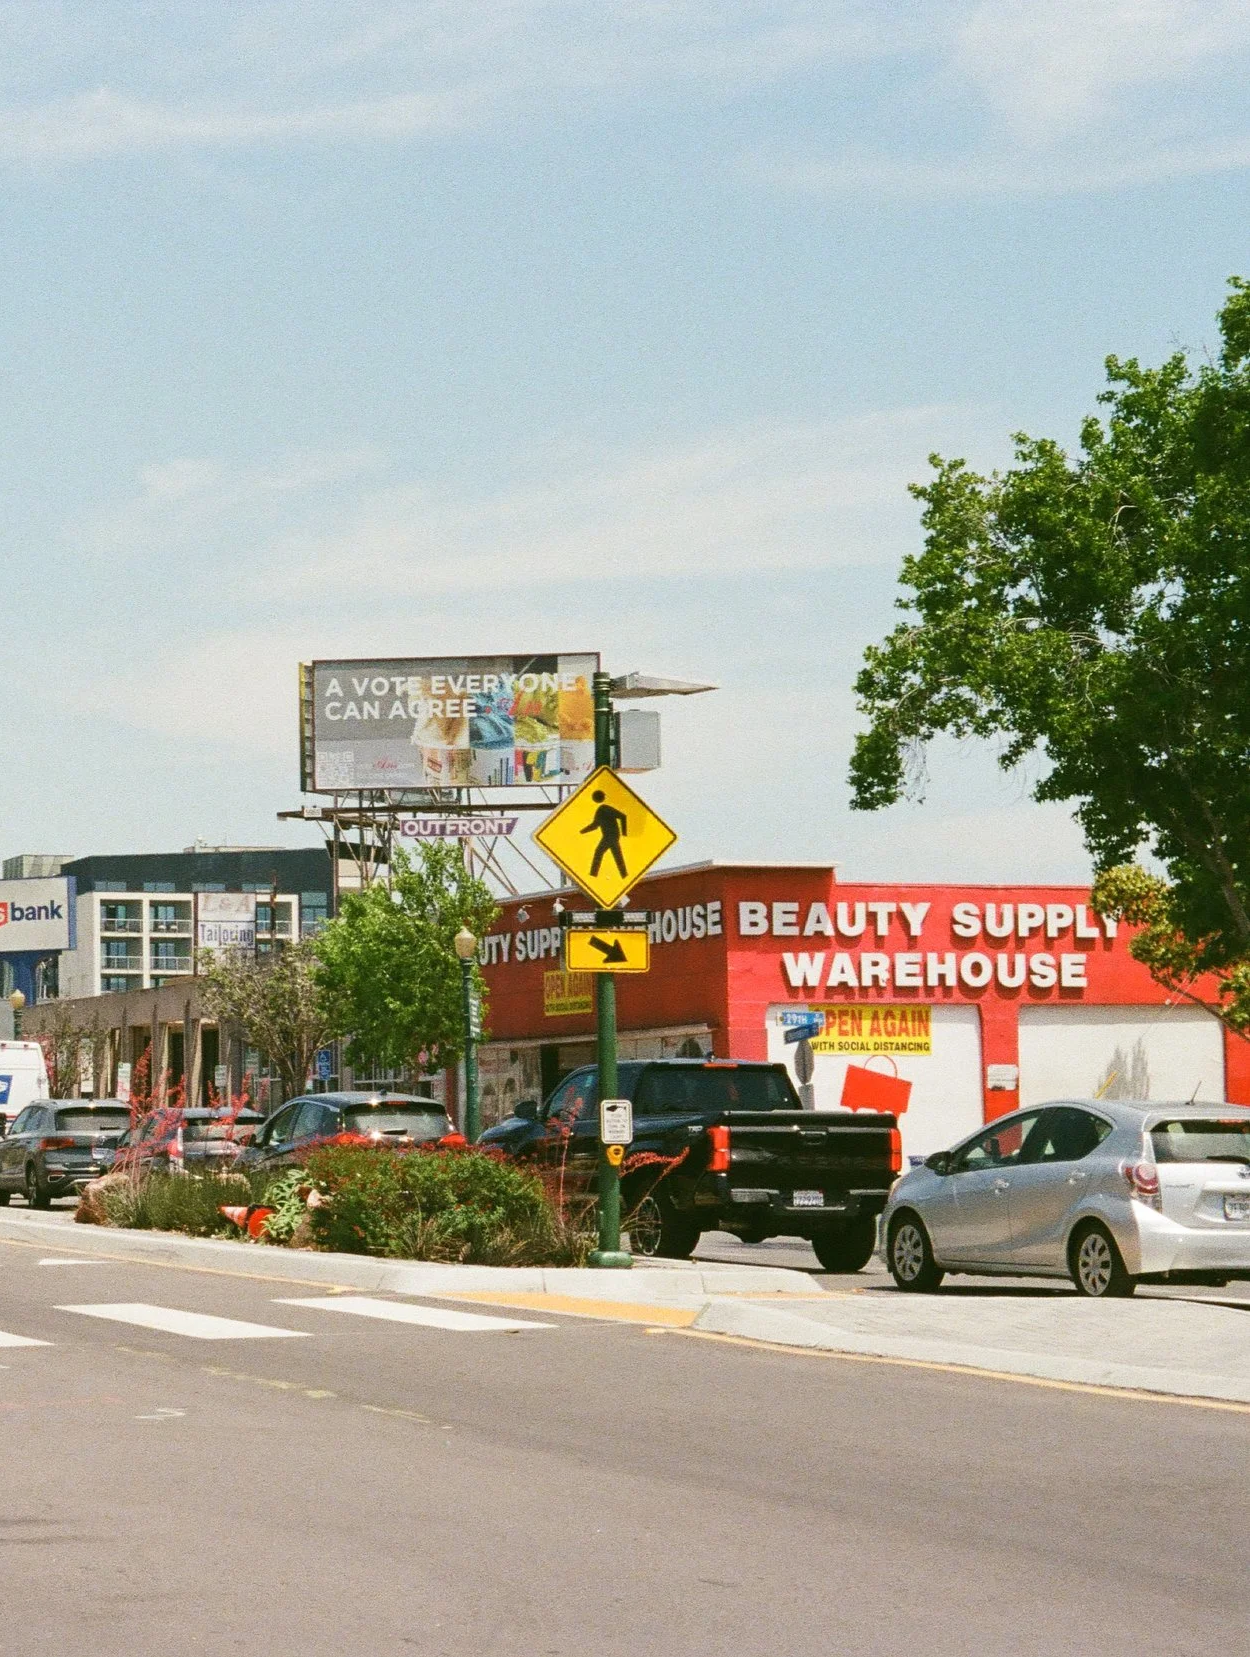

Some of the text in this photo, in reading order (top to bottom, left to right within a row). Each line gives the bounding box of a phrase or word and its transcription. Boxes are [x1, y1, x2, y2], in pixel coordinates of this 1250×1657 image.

[325, 672, 578, 698] A VOTE EVERYONE
[324, 700, 381, 721] CAN
[388, 698, 478, 719] AGREE
[403, 819, 512, 836] OUTFRONT
[10, 900, 64, 921] bank
[738, 902, 1120, 939] BEAUTY SUPPLY
[200, 924, 254, 946] Tailoring
[515, 927, 561, 961] SUPP
[650, 901, 723, 944] HOUSE
[782, 952, 1088, 988] WAREHOUSE
[869, 1009, 930, 1037] AGAIN
[811, 1041, 930, 1052] WITH SOCIAL DISTANCING
